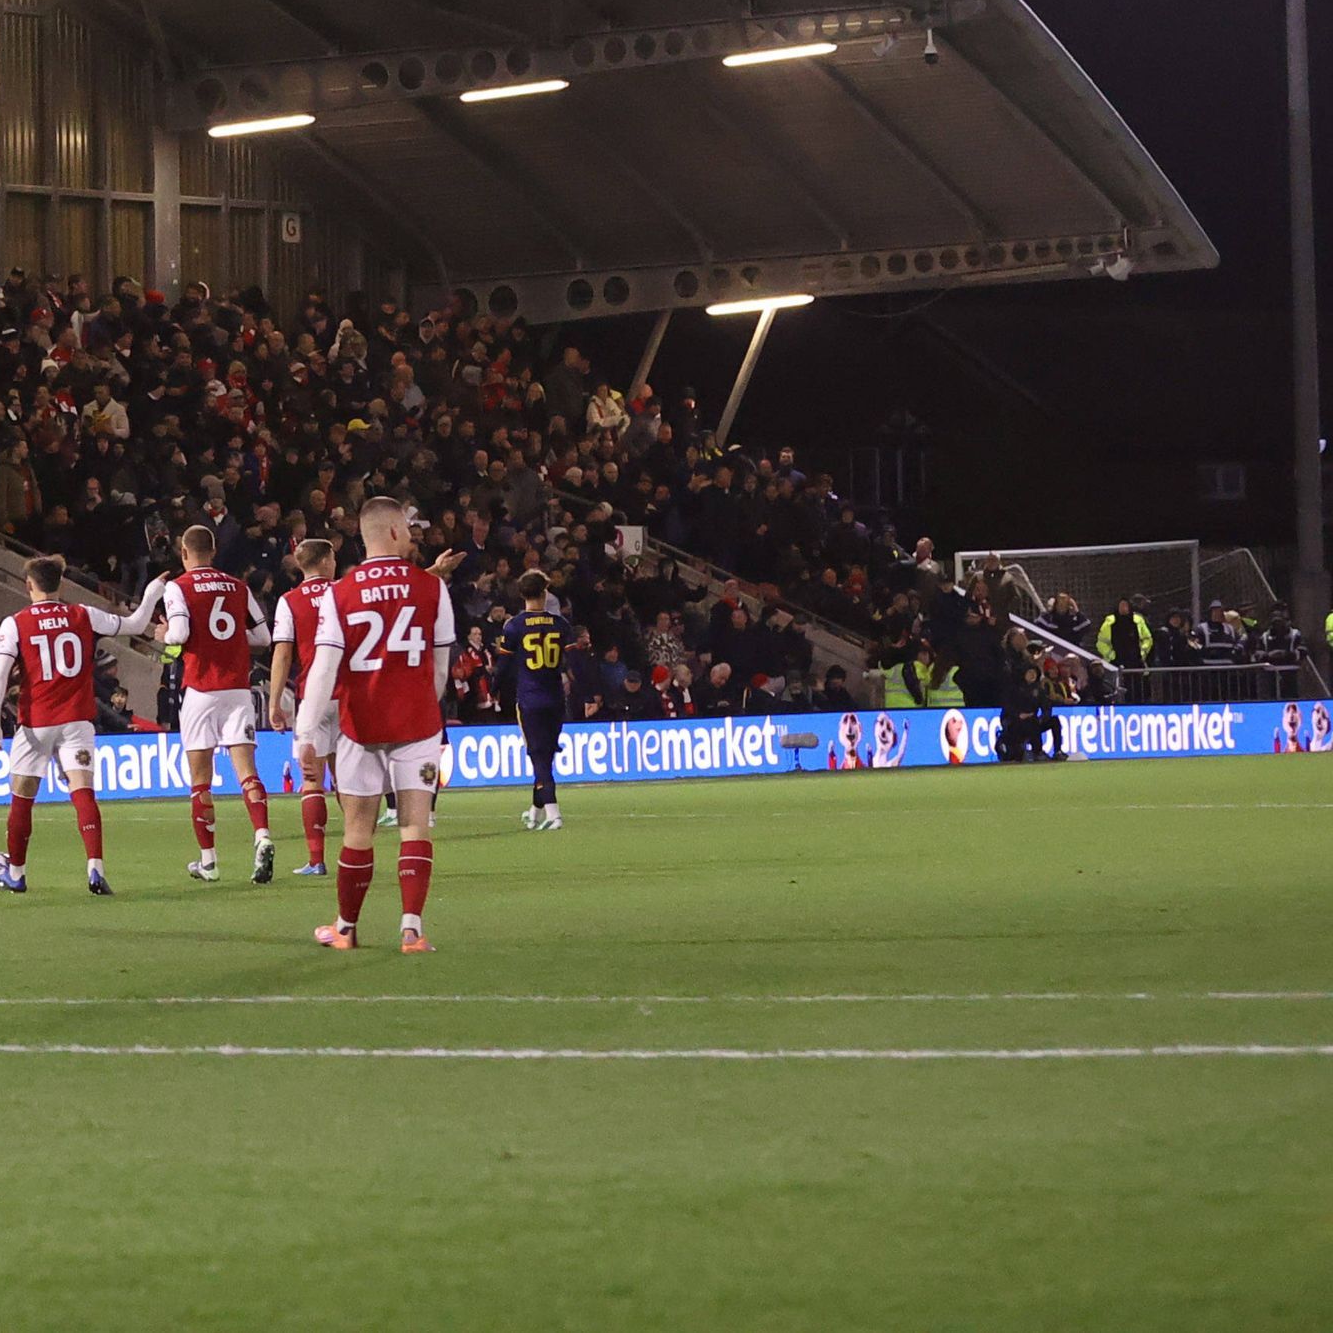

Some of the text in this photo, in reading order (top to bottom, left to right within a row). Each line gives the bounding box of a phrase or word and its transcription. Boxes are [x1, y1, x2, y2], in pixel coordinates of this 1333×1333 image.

[286, 218, 297, 237] G
[354, 565, 409, 583] BOXT
[193, 581, 237, 593] BENNETT
[301, 581, 329, 595] BOX
[360, 584, 410, 604] BATTY
[39, 617, 69, 630] HELM
[209, 595, 236, 641] 6
[346, 605, 426, 672] 24
[30, 632, 83, 681] 10
[522, 632, 561, 670] 56
